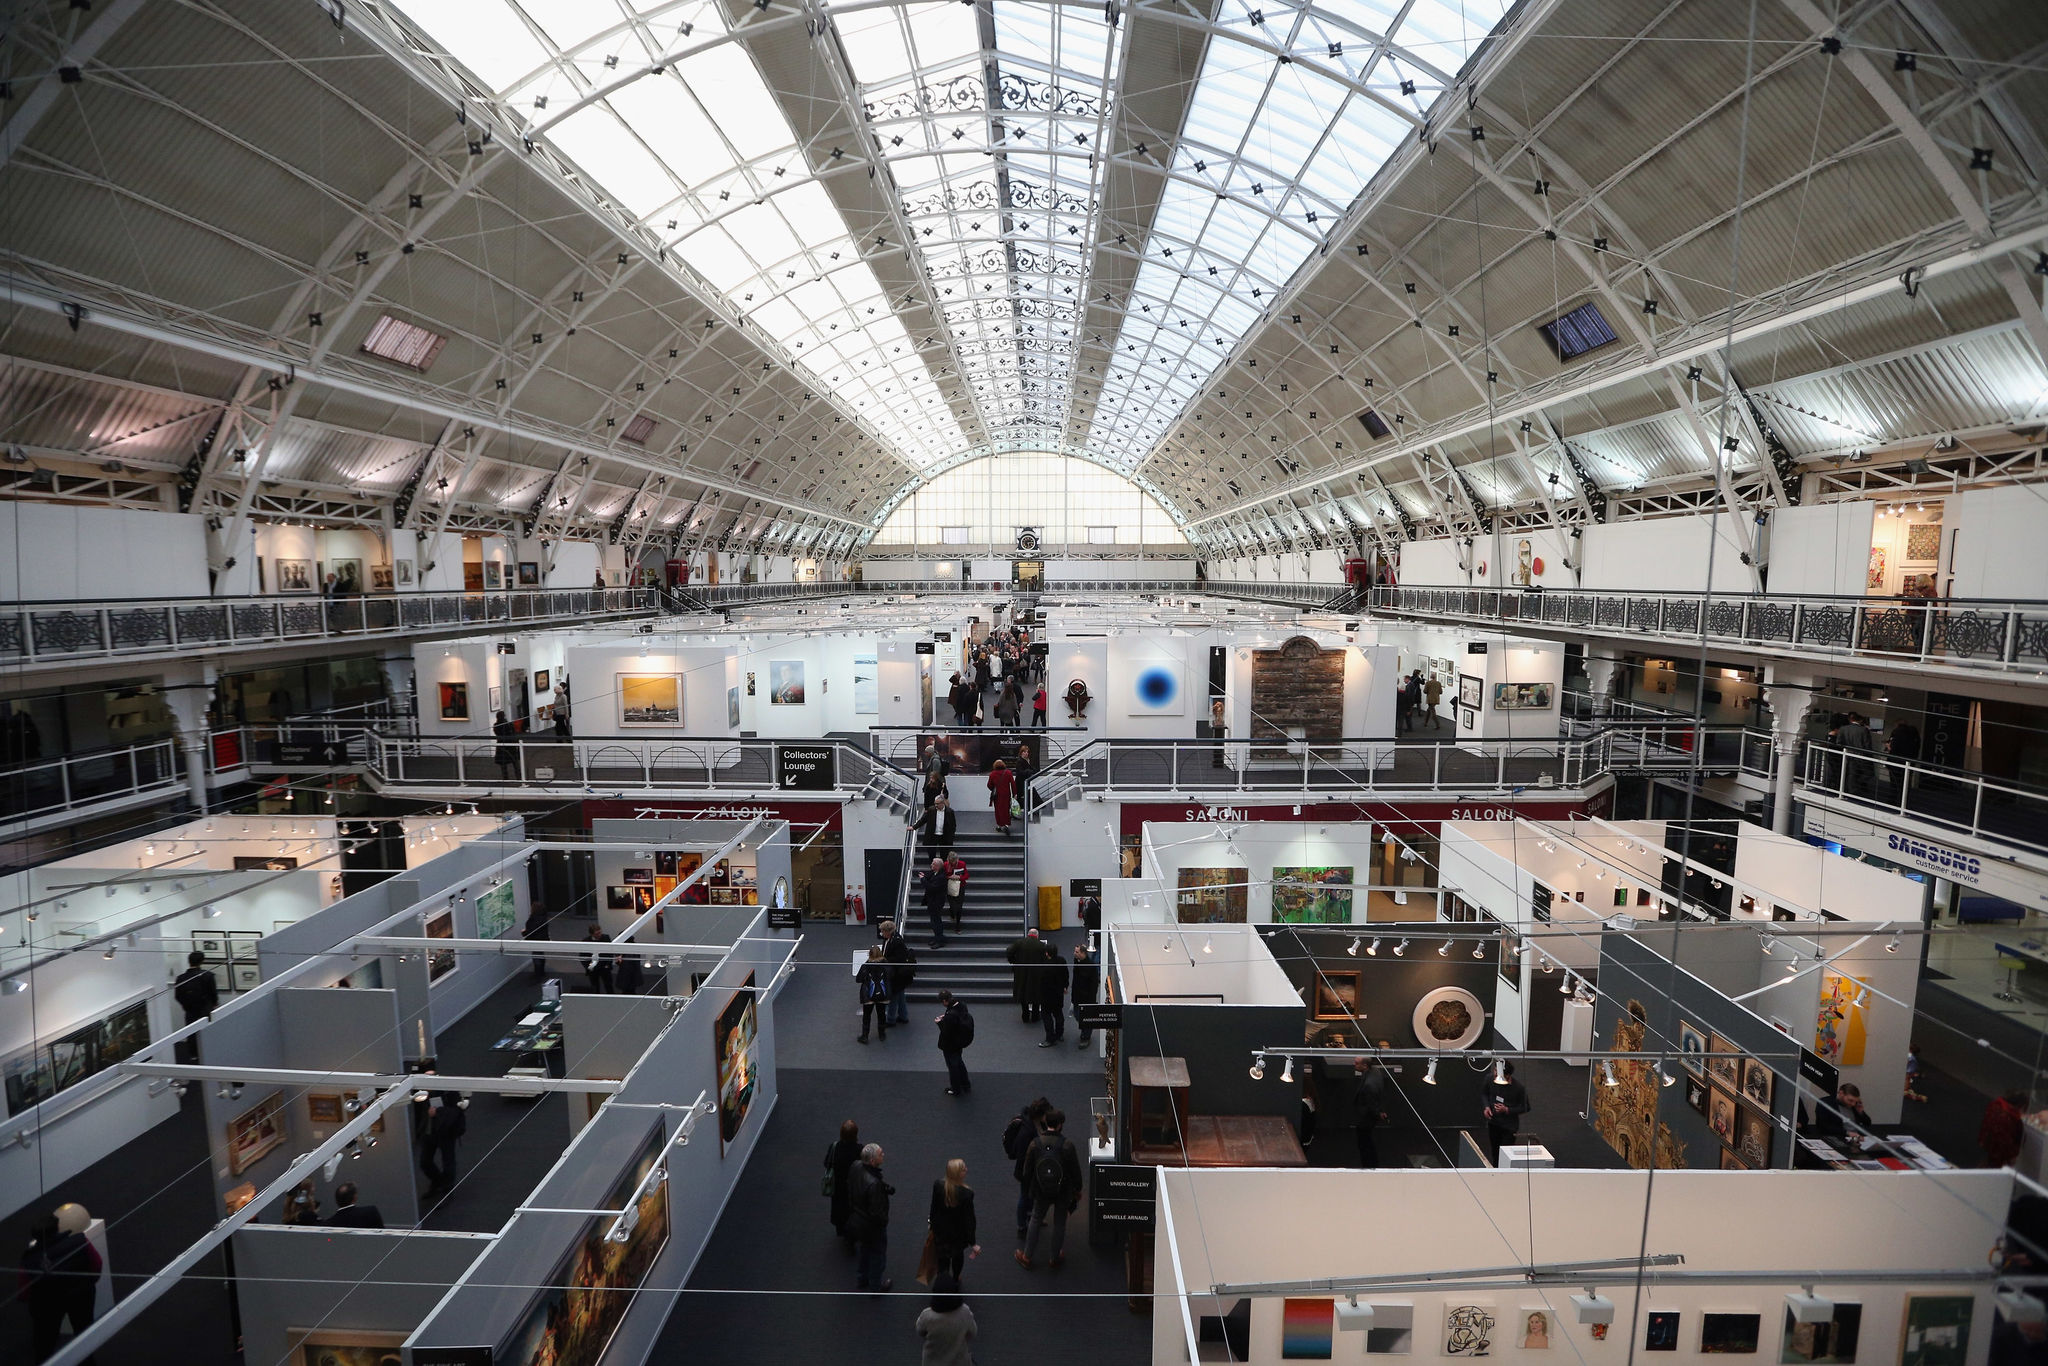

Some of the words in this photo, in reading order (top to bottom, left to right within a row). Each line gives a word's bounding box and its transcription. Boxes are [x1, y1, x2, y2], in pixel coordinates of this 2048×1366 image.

[783, 751, 829, 759] Collectors'
[784, 762, 816, 771] Lounge
[708, 806, 769, 818] SALONI
[1185, 809, 1249, 821] SALONI
[1451, 808, 1513, 821] SALONI
[1888, 834, 1981, 875] SAMSUNG
[1915, 859, 1950, 875] customer
[1951, 870, 1979, 884] service
